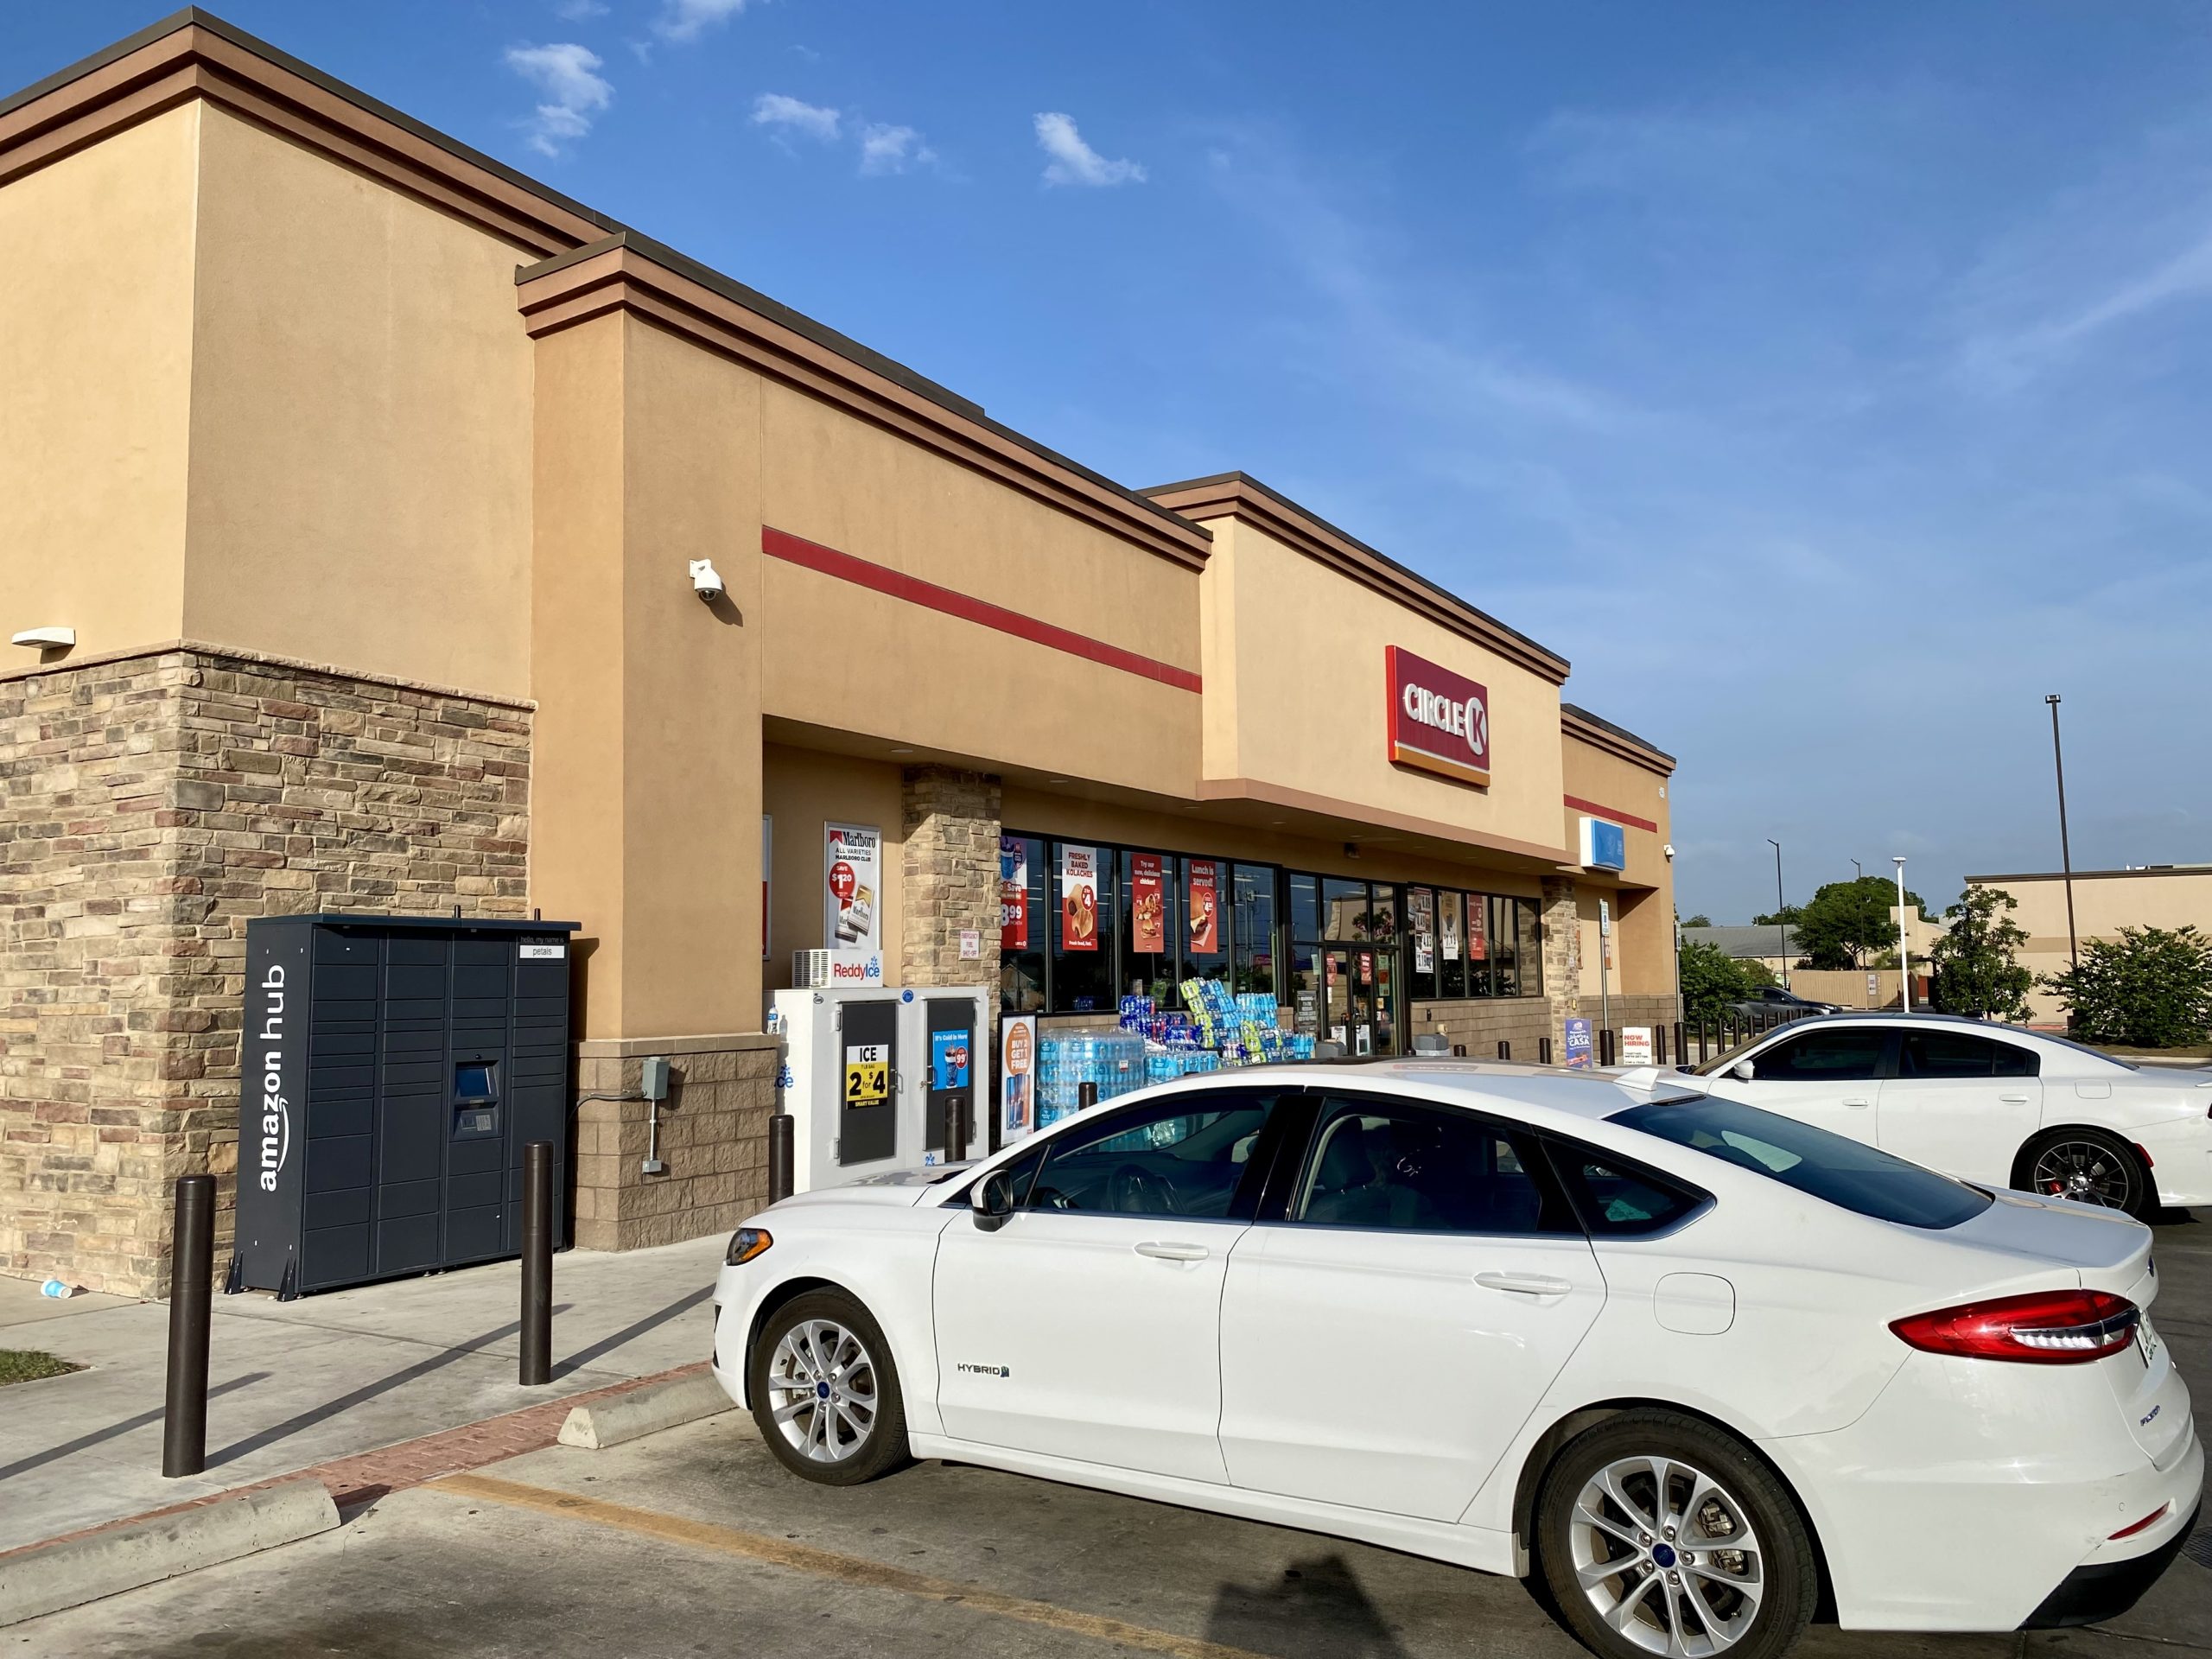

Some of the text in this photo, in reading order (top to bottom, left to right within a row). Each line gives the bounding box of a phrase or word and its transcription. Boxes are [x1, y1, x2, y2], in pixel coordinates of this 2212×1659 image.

[1403, 683, 1465, 737] CIRCLE
[842, 831, 876, 849] Marlboro
[1068, 852, 1090, 861] FRESHLY
[1071, 861, 1089, 869] BAKED
[1192, 864, 1209, 875] Lunch
[1066, 868, 1093, 878] KOLACHES
[1143, 869, 1160, 878] delicious
[1192, 877, 1213, 887] served!
[1007, 883, 1021, 892] Save
[532, 947, 552, 957] petals
[1011, 1039, 1023, 1049] BUY
[1569, 1038, 1590, 1046] CASA
[860, 1047, 876, 1062] ICE
[1011, 1049, 1024, 1059] GET
[1011, 1059, 1027, 1070] FREE
[259, 964, 285, 1192] amazon hub
[849, 1071, 862, 1096] 2
[862, 1080, 872, 1090] for
[957, 1363, 1001, 1376] HYBRID
